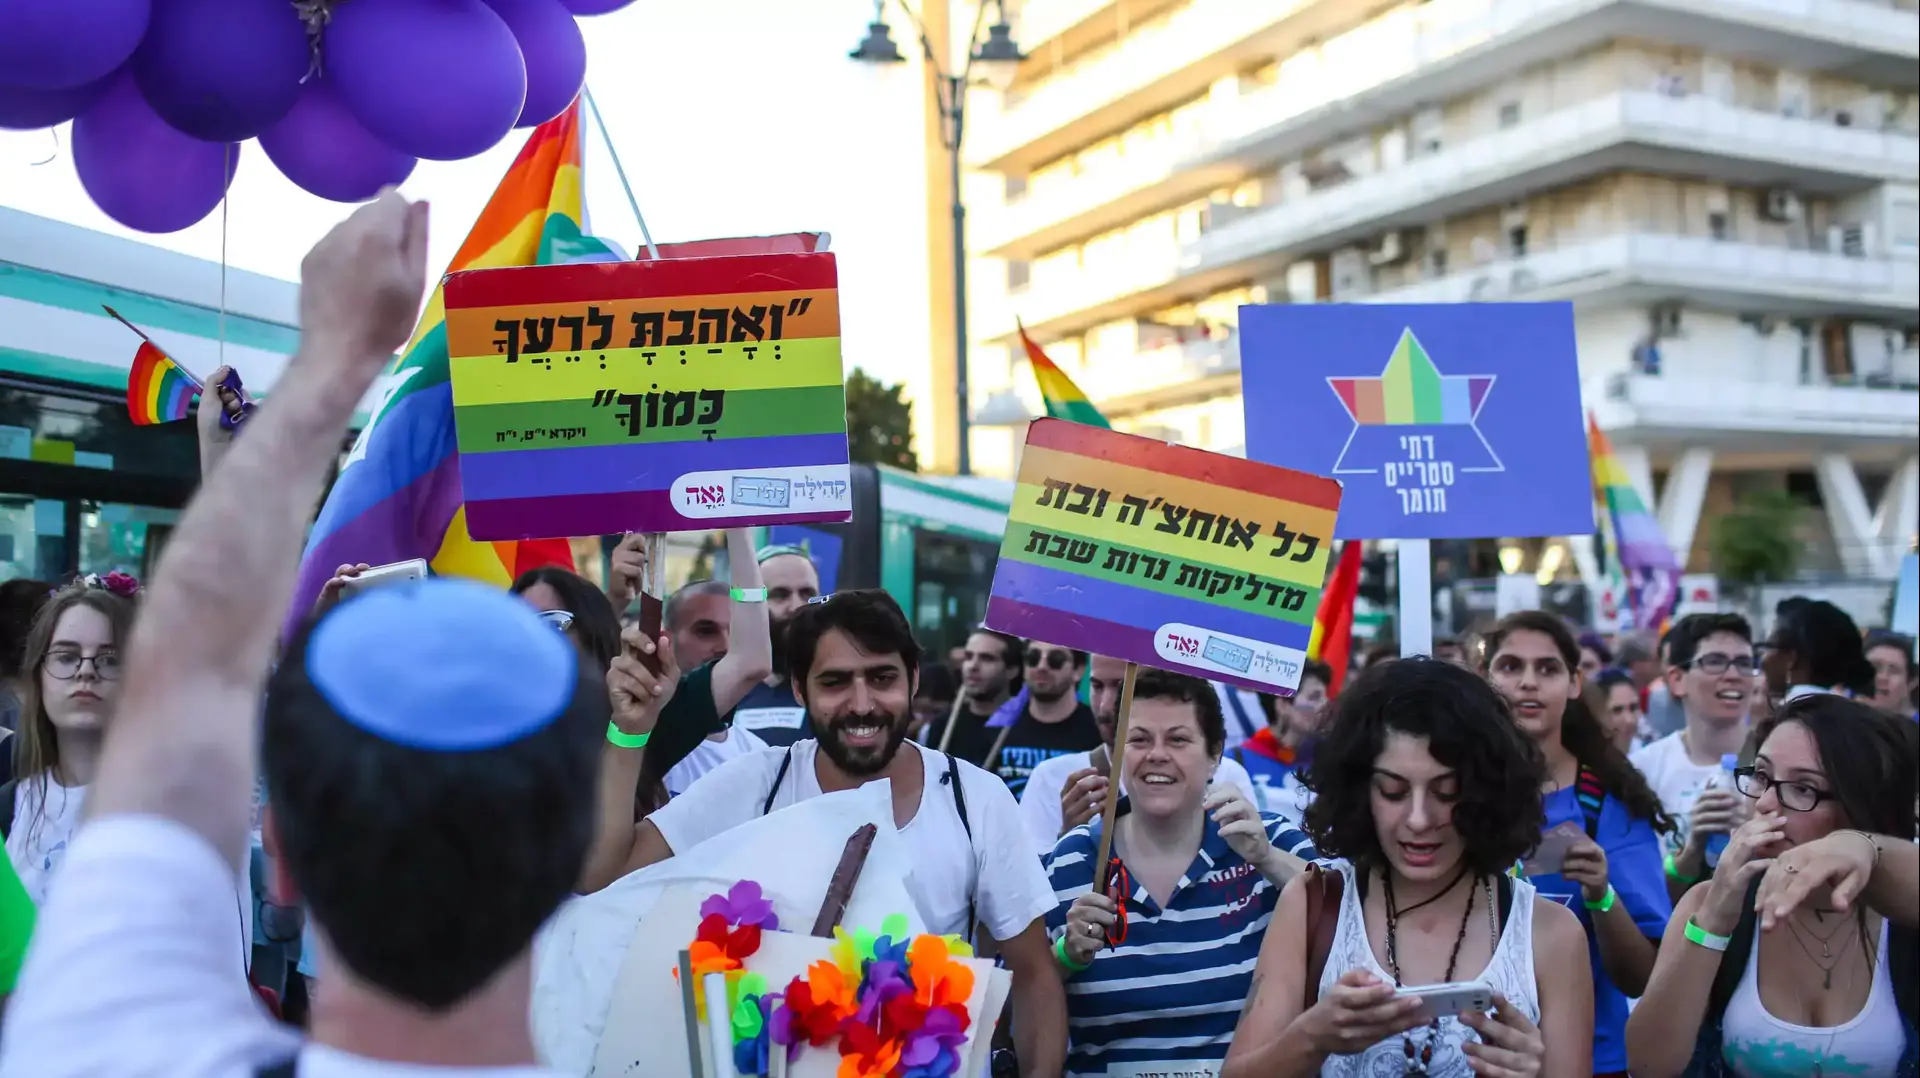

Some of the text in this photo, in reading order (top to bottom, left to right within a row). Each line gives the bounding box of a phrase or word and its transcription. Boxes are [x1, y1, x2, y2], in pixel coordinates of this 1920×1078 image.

[549, 427, 587, 441] ויקרא
[1400, 435, 1434, 460] דתי
[1036, 476, 1111, 518] ובת
[1269, 520, 1321, 563] כל
[1024, 530, 1308, 612] מדליקות נרות שבת
